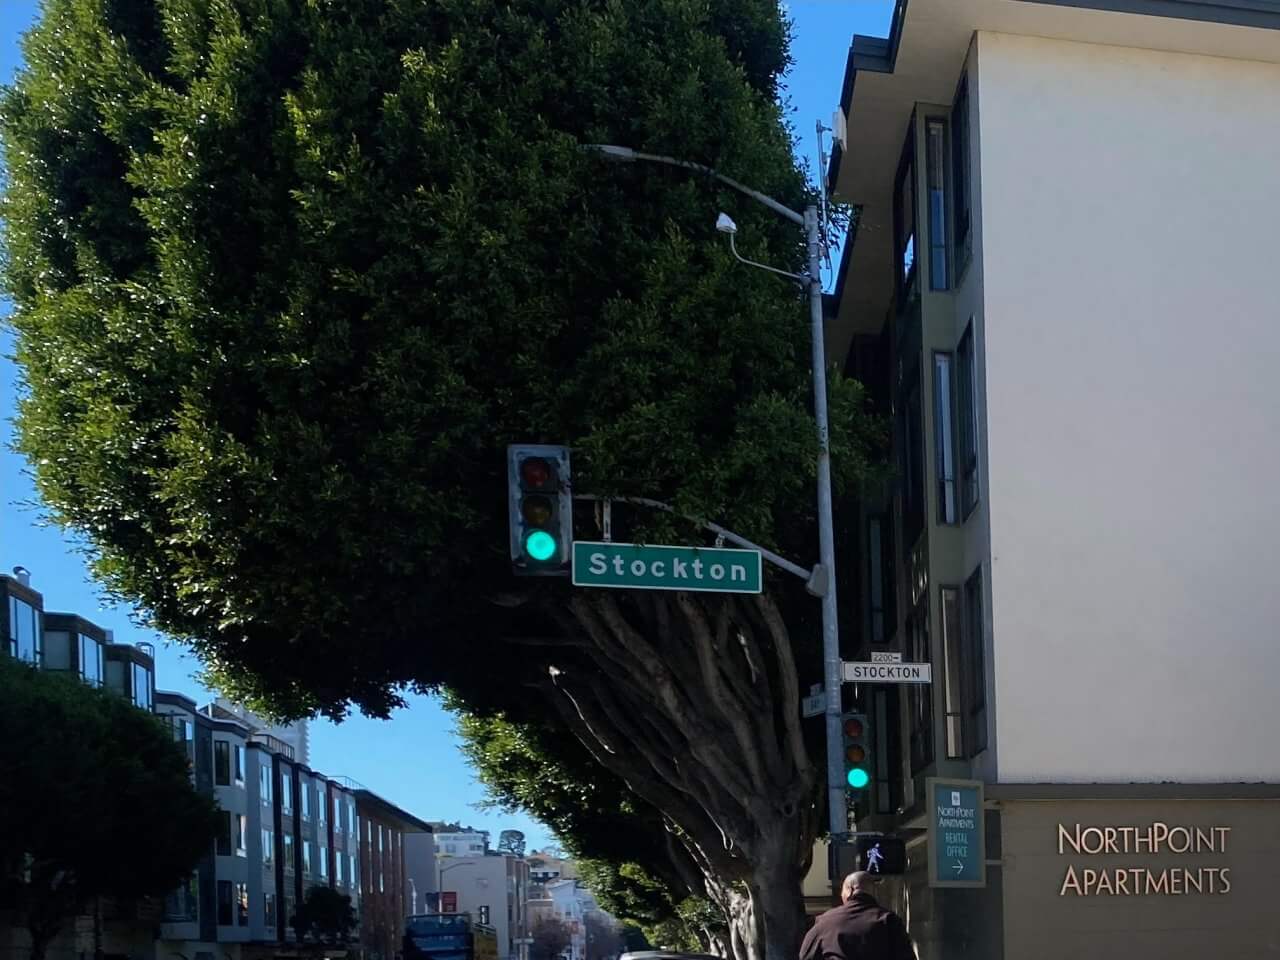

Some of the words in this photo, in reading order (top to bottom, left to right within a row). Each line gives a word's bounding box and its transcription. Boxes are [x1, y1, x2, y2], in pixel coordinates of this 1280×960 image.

[589, 553, 746, 582] Stockton
[854, 667, 920, 678] STOCKTON
[947, 846, 968, 857] OFFICE
[1058, 823, 1231, 854] NORTHPOINT
[1060, 865, 1231, 896] APARTMENTS
